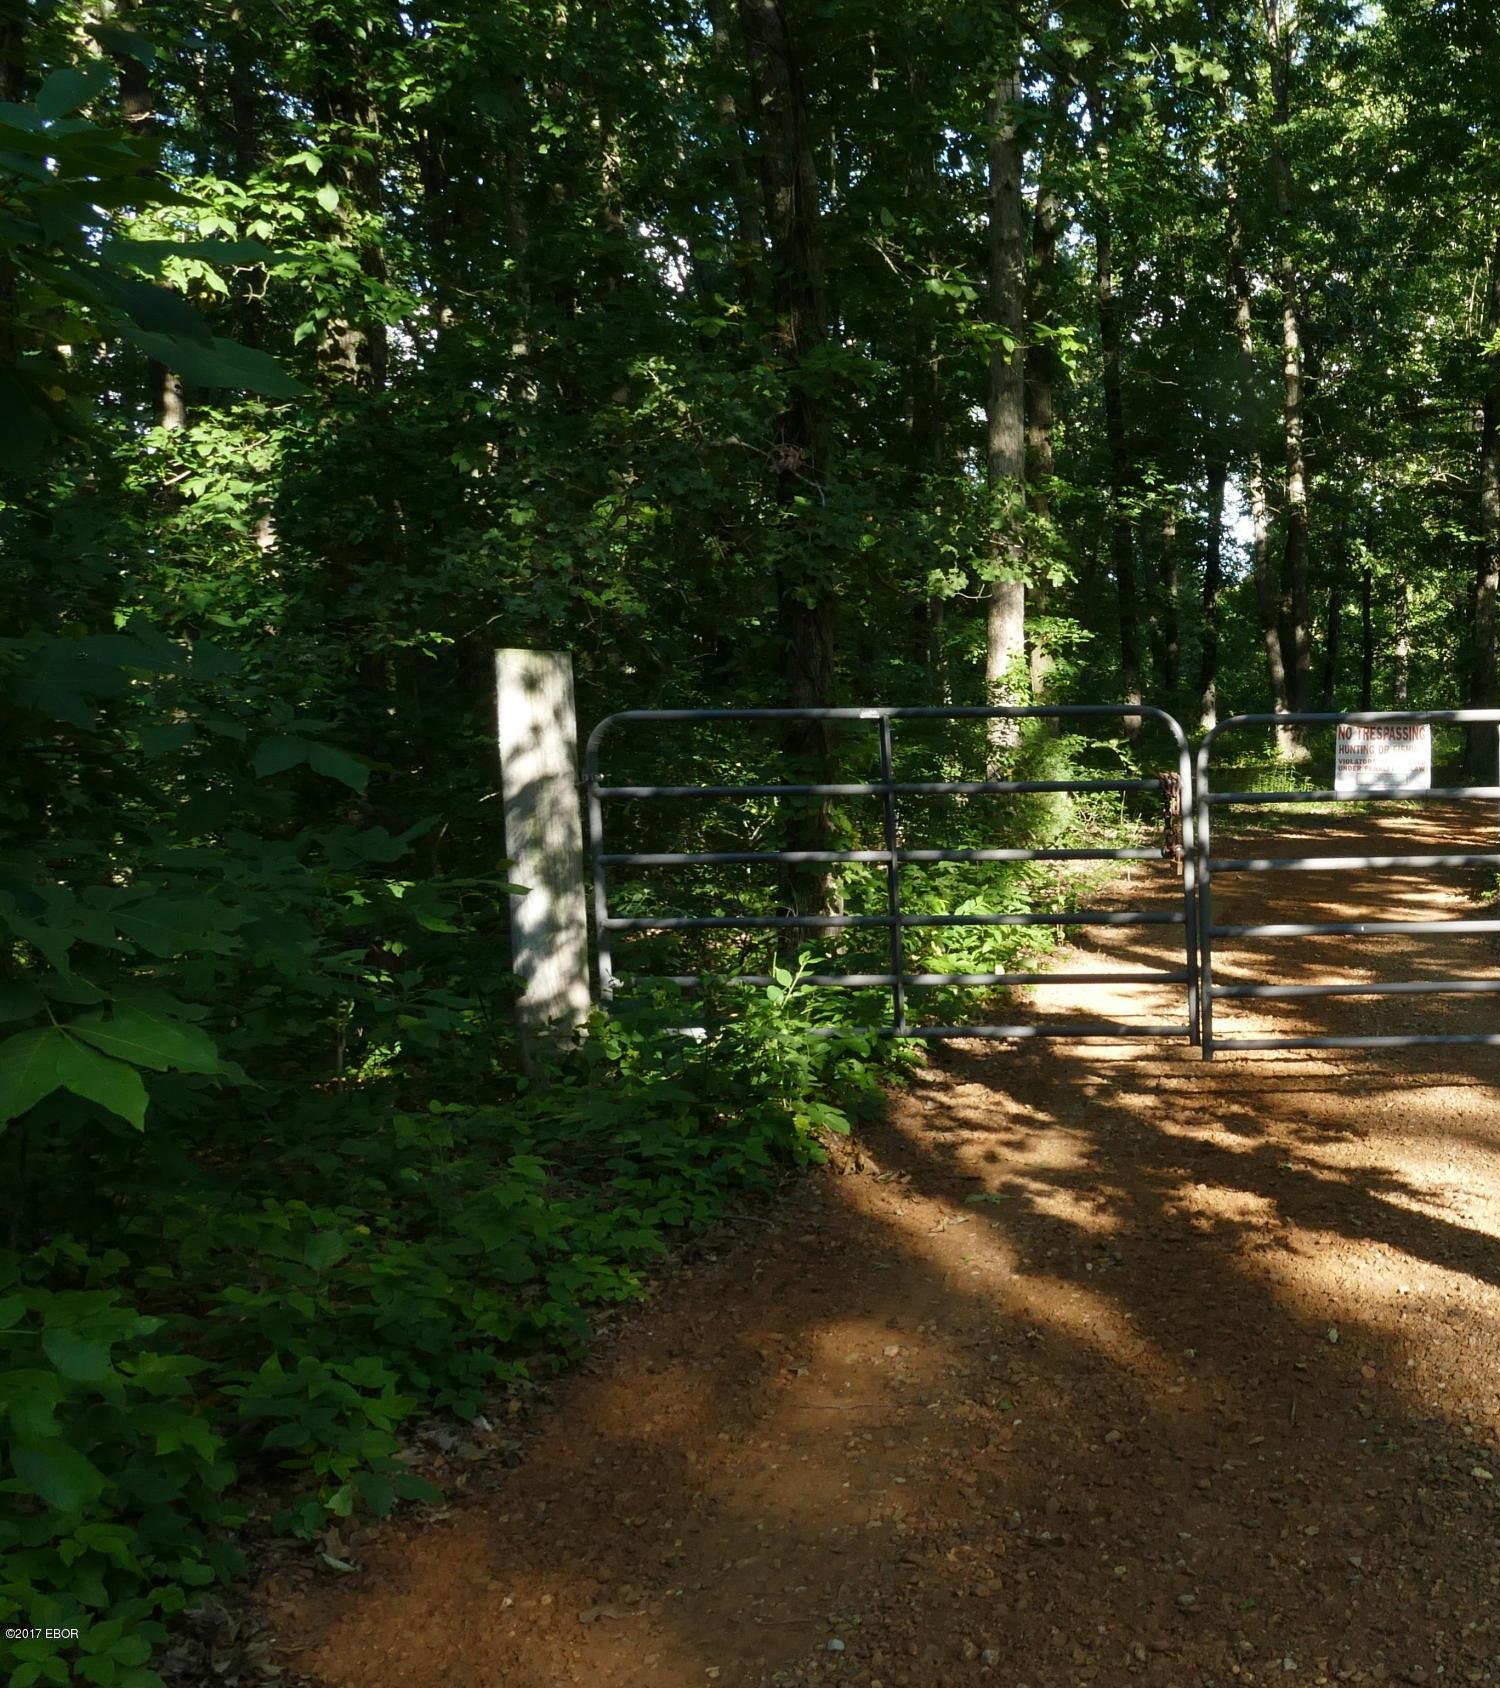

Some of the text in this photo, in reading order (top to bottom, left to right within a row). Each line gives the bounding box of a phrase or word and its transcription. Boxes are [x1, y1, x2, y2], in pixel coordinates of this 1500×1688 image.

[1338, 726, 1426, 741] NO TRESPASSING
[1338, 744, 1375, 754] HUNTING
[1378, 745, 1390, 754] OR
